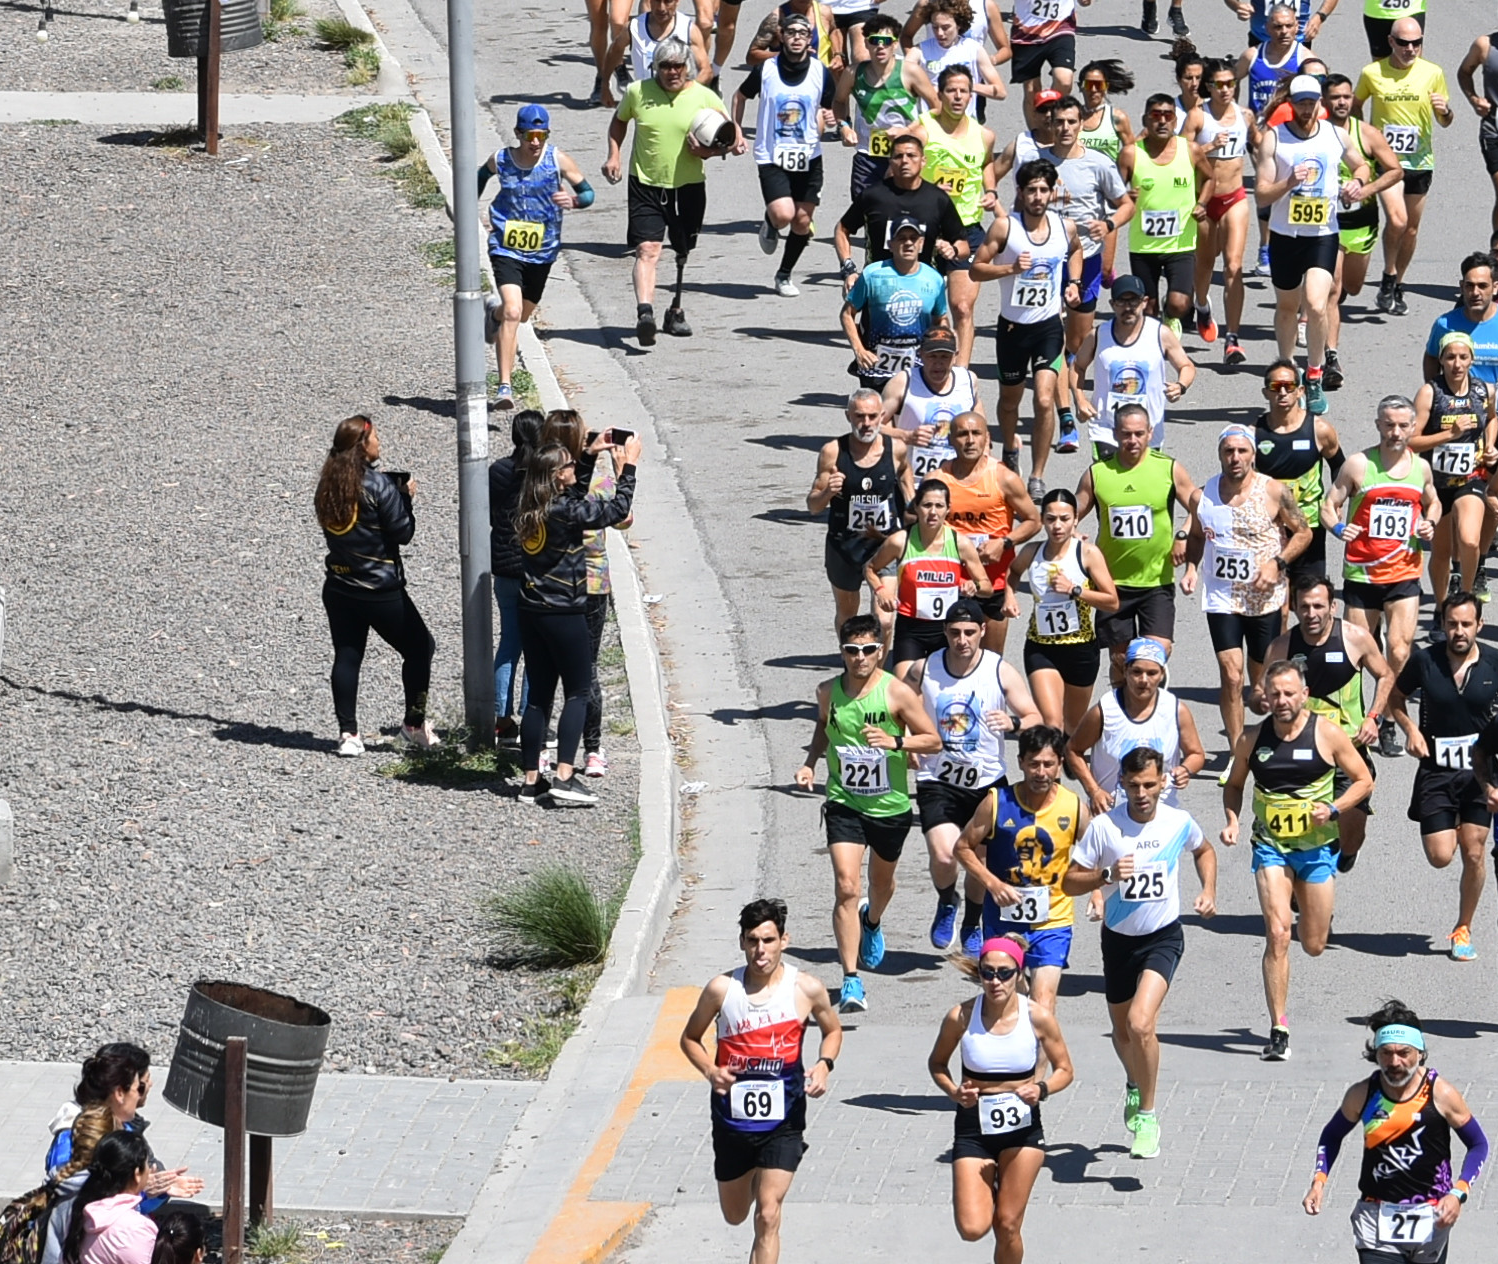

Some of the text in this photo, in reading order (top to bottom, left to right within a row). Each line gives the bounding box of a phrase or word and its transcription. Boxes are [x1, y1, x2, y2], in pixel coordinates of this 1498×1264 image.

[1032, 0, 1060, 19] 213
[1385, 131, 1416, 153] 252
[777, 150, 806, 170] 158
[1173, 176, 1188, 188] NLA
[1293, 203, 1324, 224] 595
[1145, 216, 1177, 236] 227
[507, 228, 539, 249] 630
[1015, 287, 1048, 307] 123
[878, 353, 911, 371] 276
[1437, 451, 1470, 473] 175
[852, 510, 886, 529] 254
[1112, 516, 1149, 538] 210
[1372, 515, 1407, 537] 193
[917, 570, 955, 582] MILLA
[1215, 557, 1250, 581] 253
[932, 597, 944, 618] 9
[1044, 611, 1070, 634] 13
[864, 711, 887, 724] NLA
[845, 763, 881, 787] 221
[938, 761, 978, 787] 219
[1270, 813, 1310, 834] 411
[1136, 839, 1160, 849] ARG
[1124, 872, 1164, 900] 225
[1011, 898, 1038, 922] 33
[743, 1091, 772, 1118] 69
[990, 1106, 1022, 1129] 93
[1391, 1213, 1420, 1240] 27
